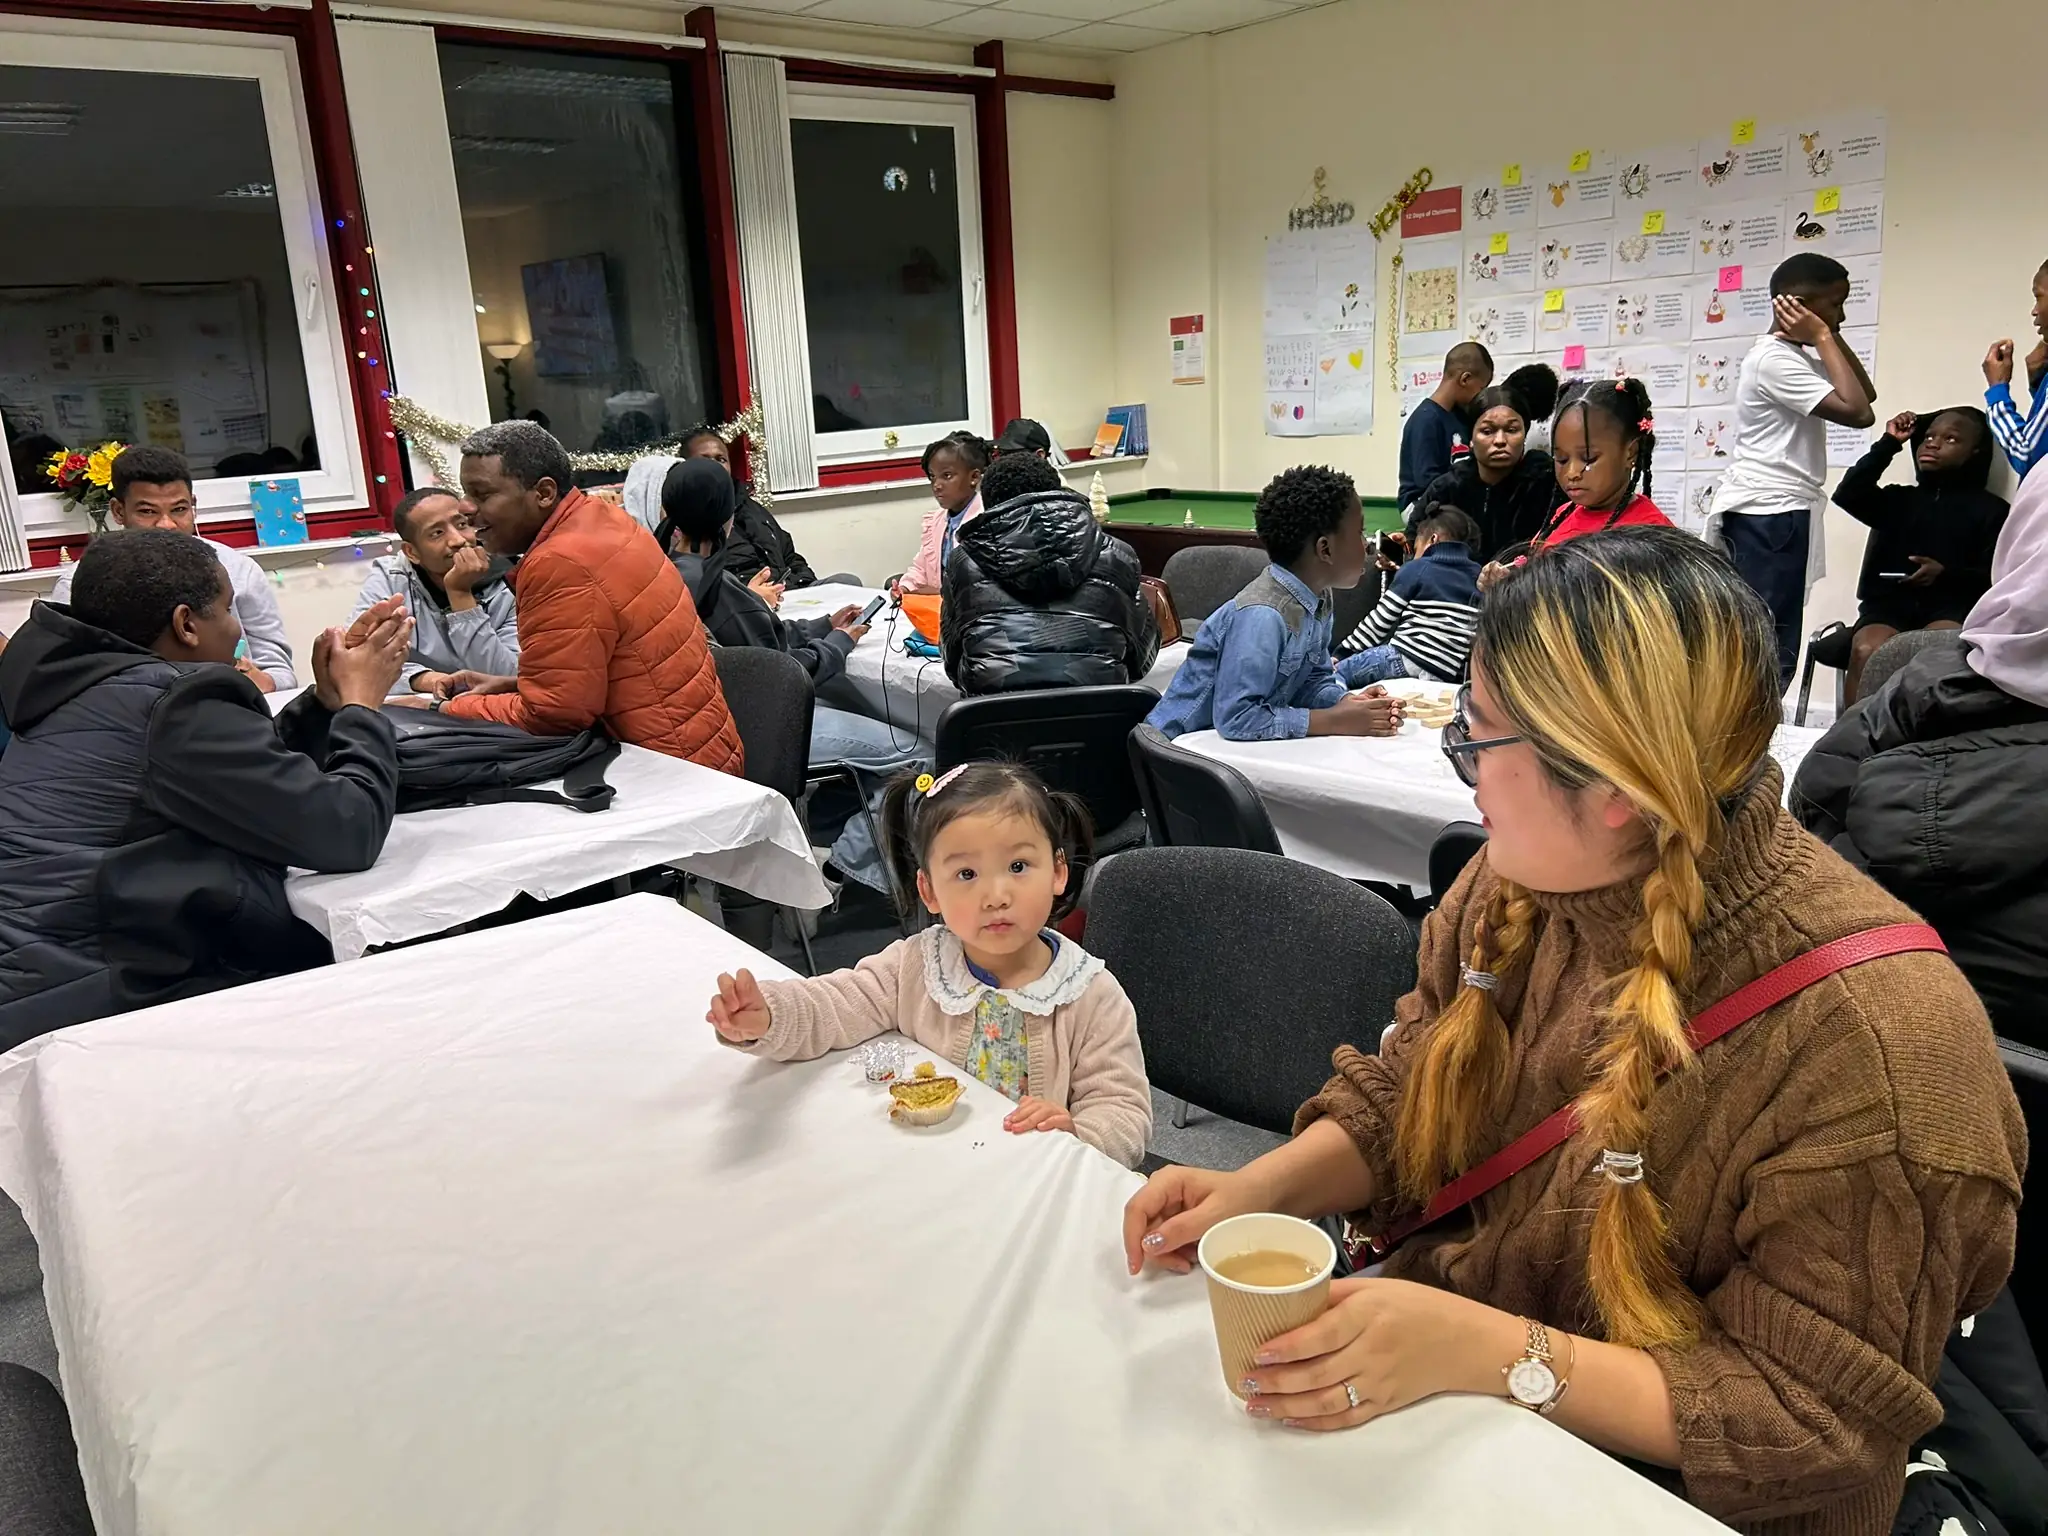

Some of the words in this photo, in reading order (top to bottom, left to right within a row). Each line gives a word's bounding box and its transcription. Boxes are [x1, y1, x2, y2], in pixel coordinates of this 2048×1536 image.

[1406, 212, 1413, 220] 12
[1413, 211, 1425, 221] Days
[1425, 208, 1431, 217] of
[1413, 371, 1428, 387] 12
